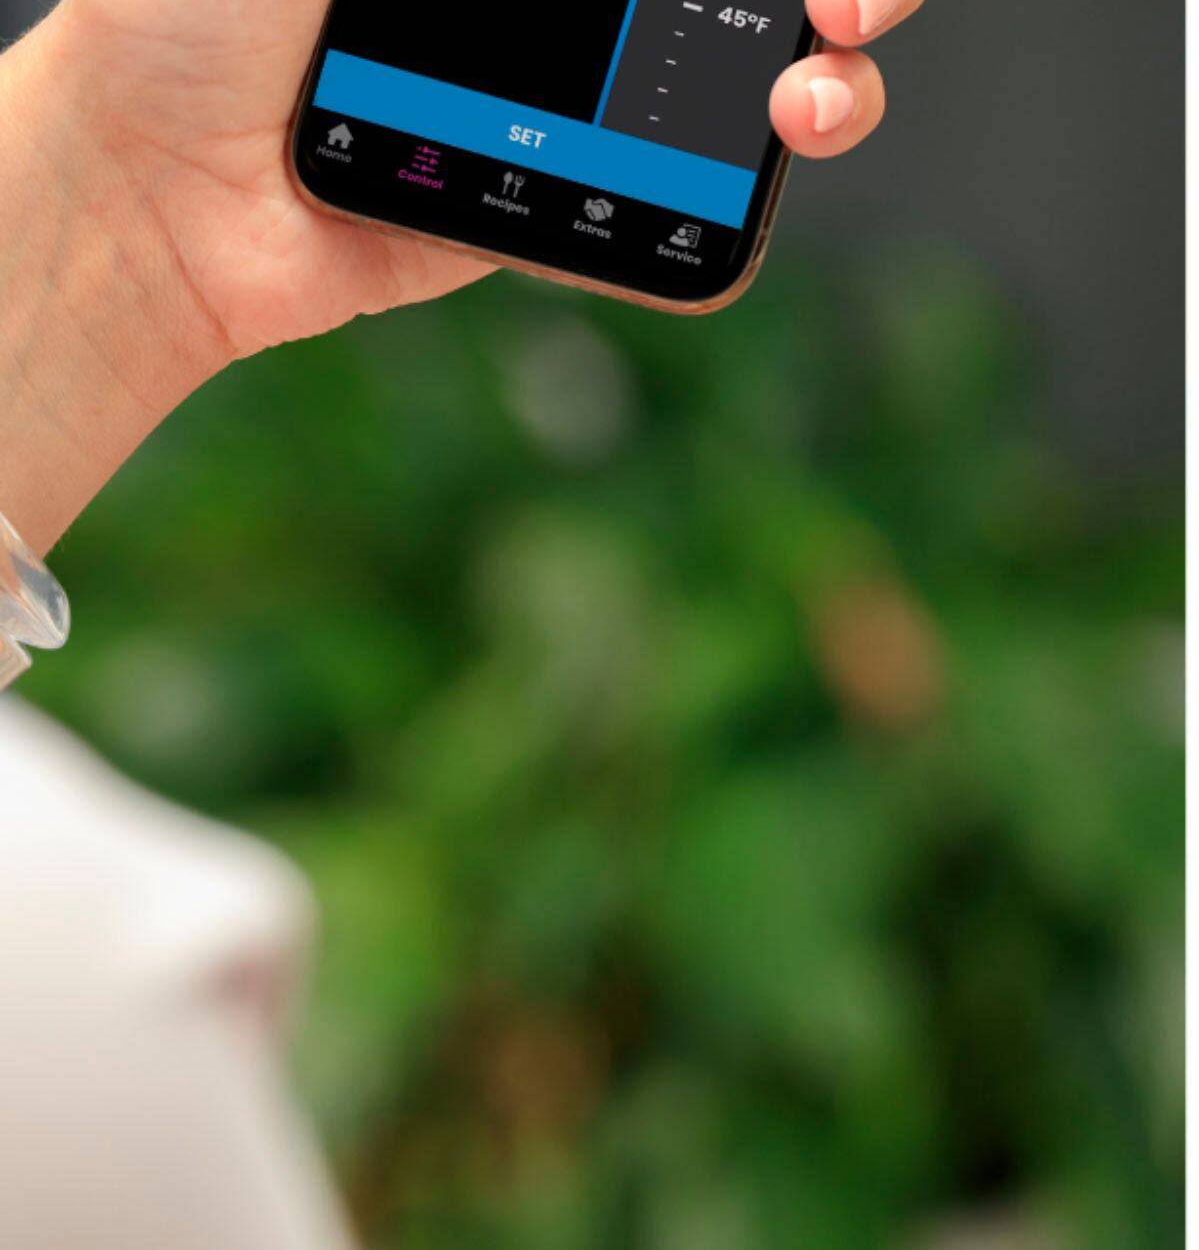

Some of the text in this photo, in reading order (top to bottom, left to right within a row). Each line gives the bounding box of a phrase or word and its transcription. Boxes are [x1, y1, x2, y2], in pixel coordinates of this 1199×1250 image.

[508, 124, 548, 149] SET
[398, 169, 444, 190] Control
[573, 219, 613, 240] Extras
